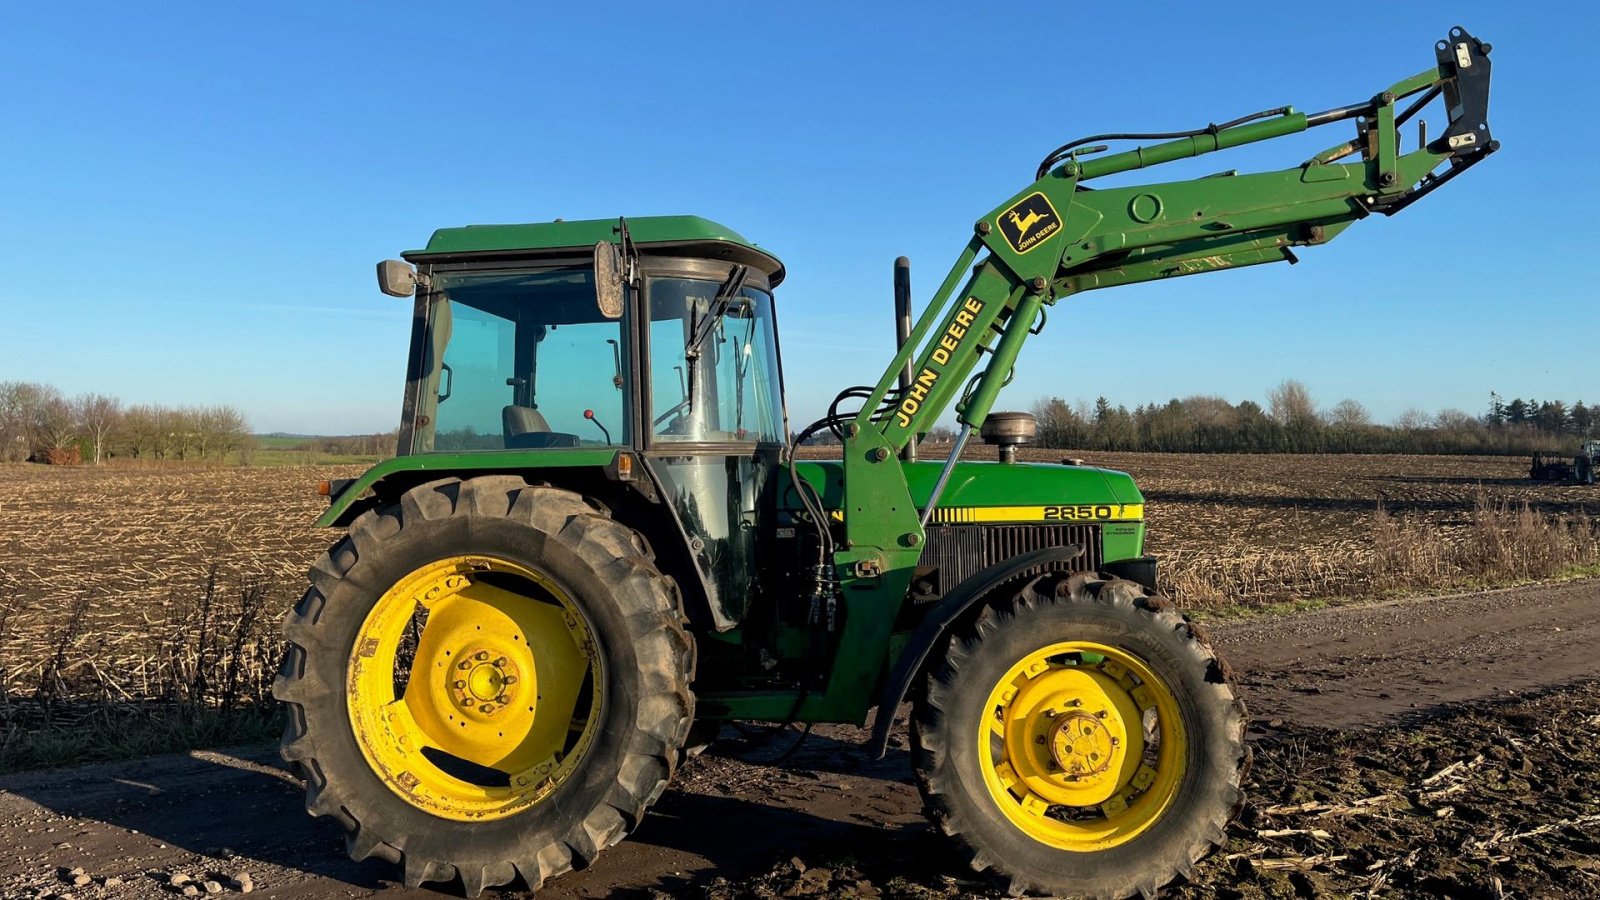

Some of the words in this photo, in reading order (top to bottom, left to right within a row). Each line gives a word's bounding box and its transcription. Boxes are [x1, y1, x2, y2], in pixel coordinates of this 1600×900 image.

[1018, 236, 1037, 251] JOHN
[1035, 222, 1058, 239] DEERE
[896, 368, 939, 429] JOHN
[931, 296, 984, 366] DEERE
[1044, 506, 1111, 520] 2850
